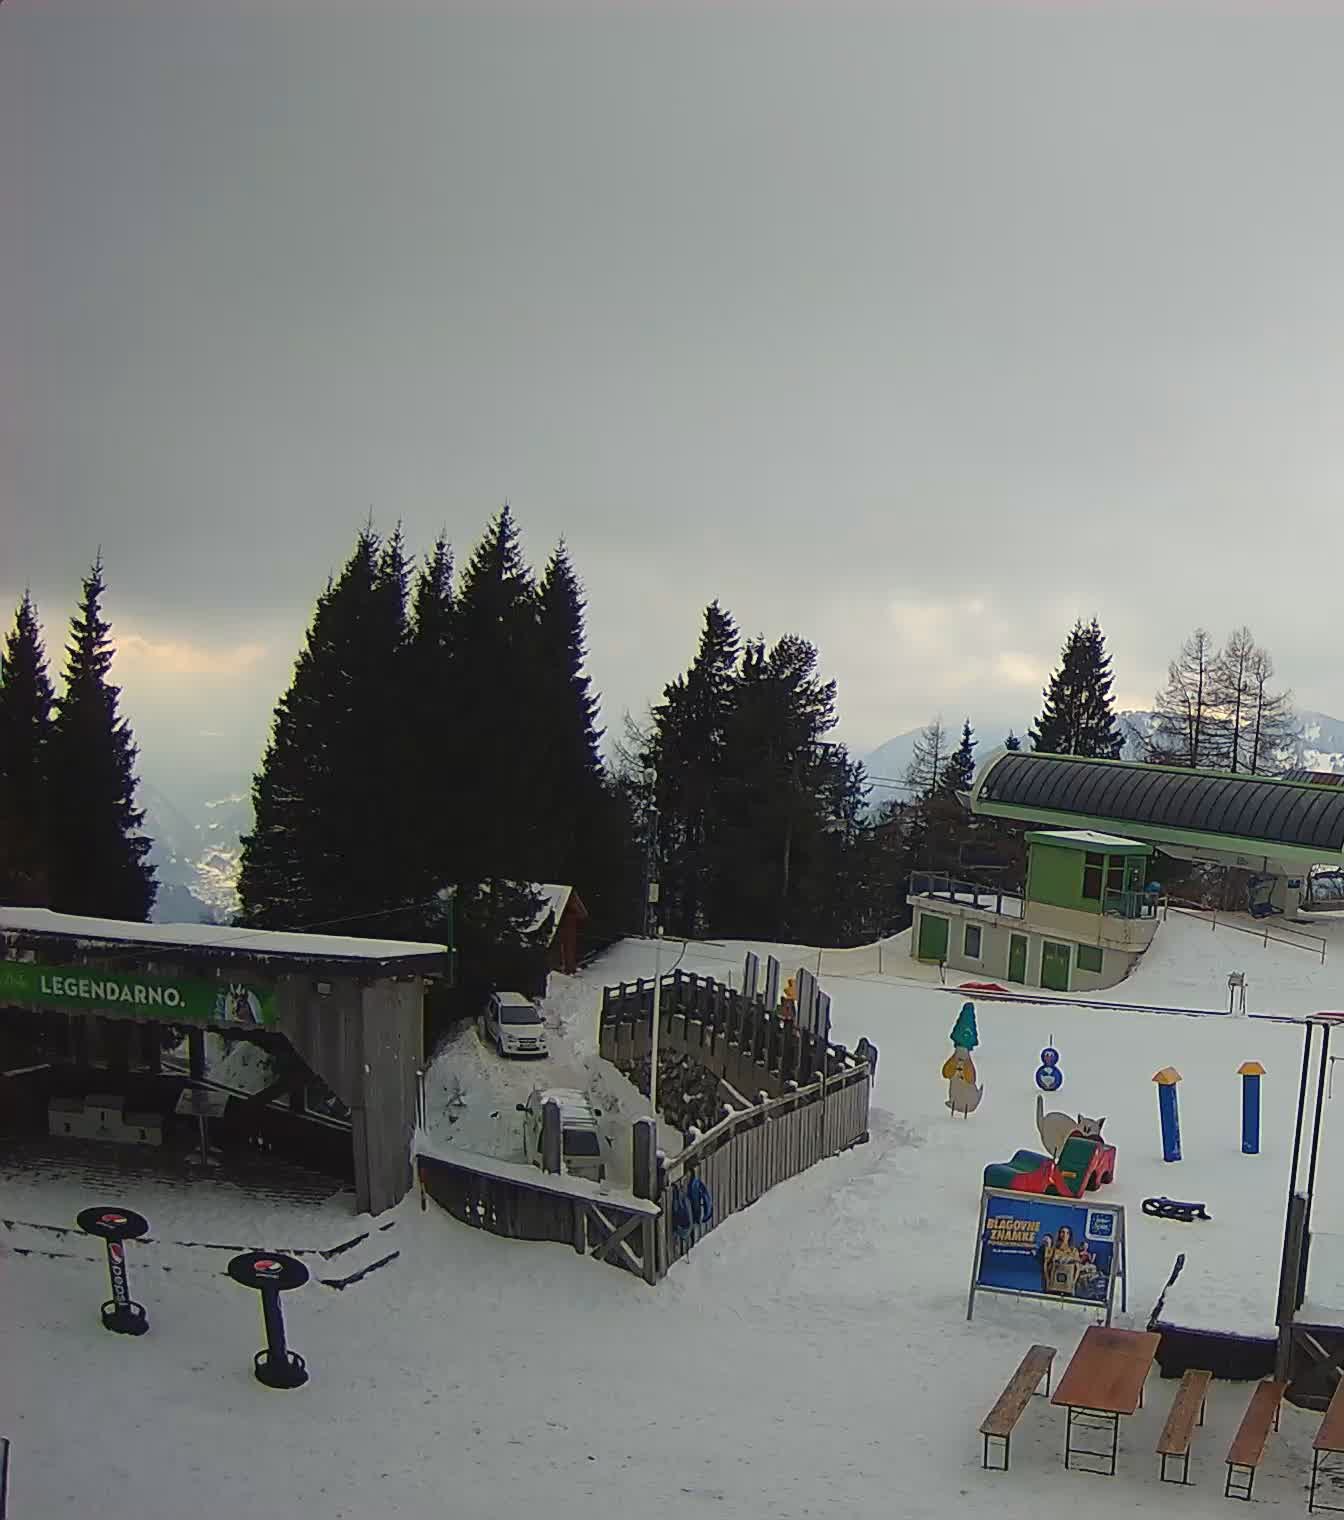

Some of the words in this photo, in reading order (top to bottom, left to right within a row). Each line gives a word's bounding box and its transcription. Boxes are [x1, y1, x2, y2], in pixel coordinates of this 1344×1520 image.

[40, 975, 186, 1007] LEGENDARNO.
[986, 1218, 1041, 1232] BLAGOVNE
[990, 1229, 1036, 1242] ZNAMKE
